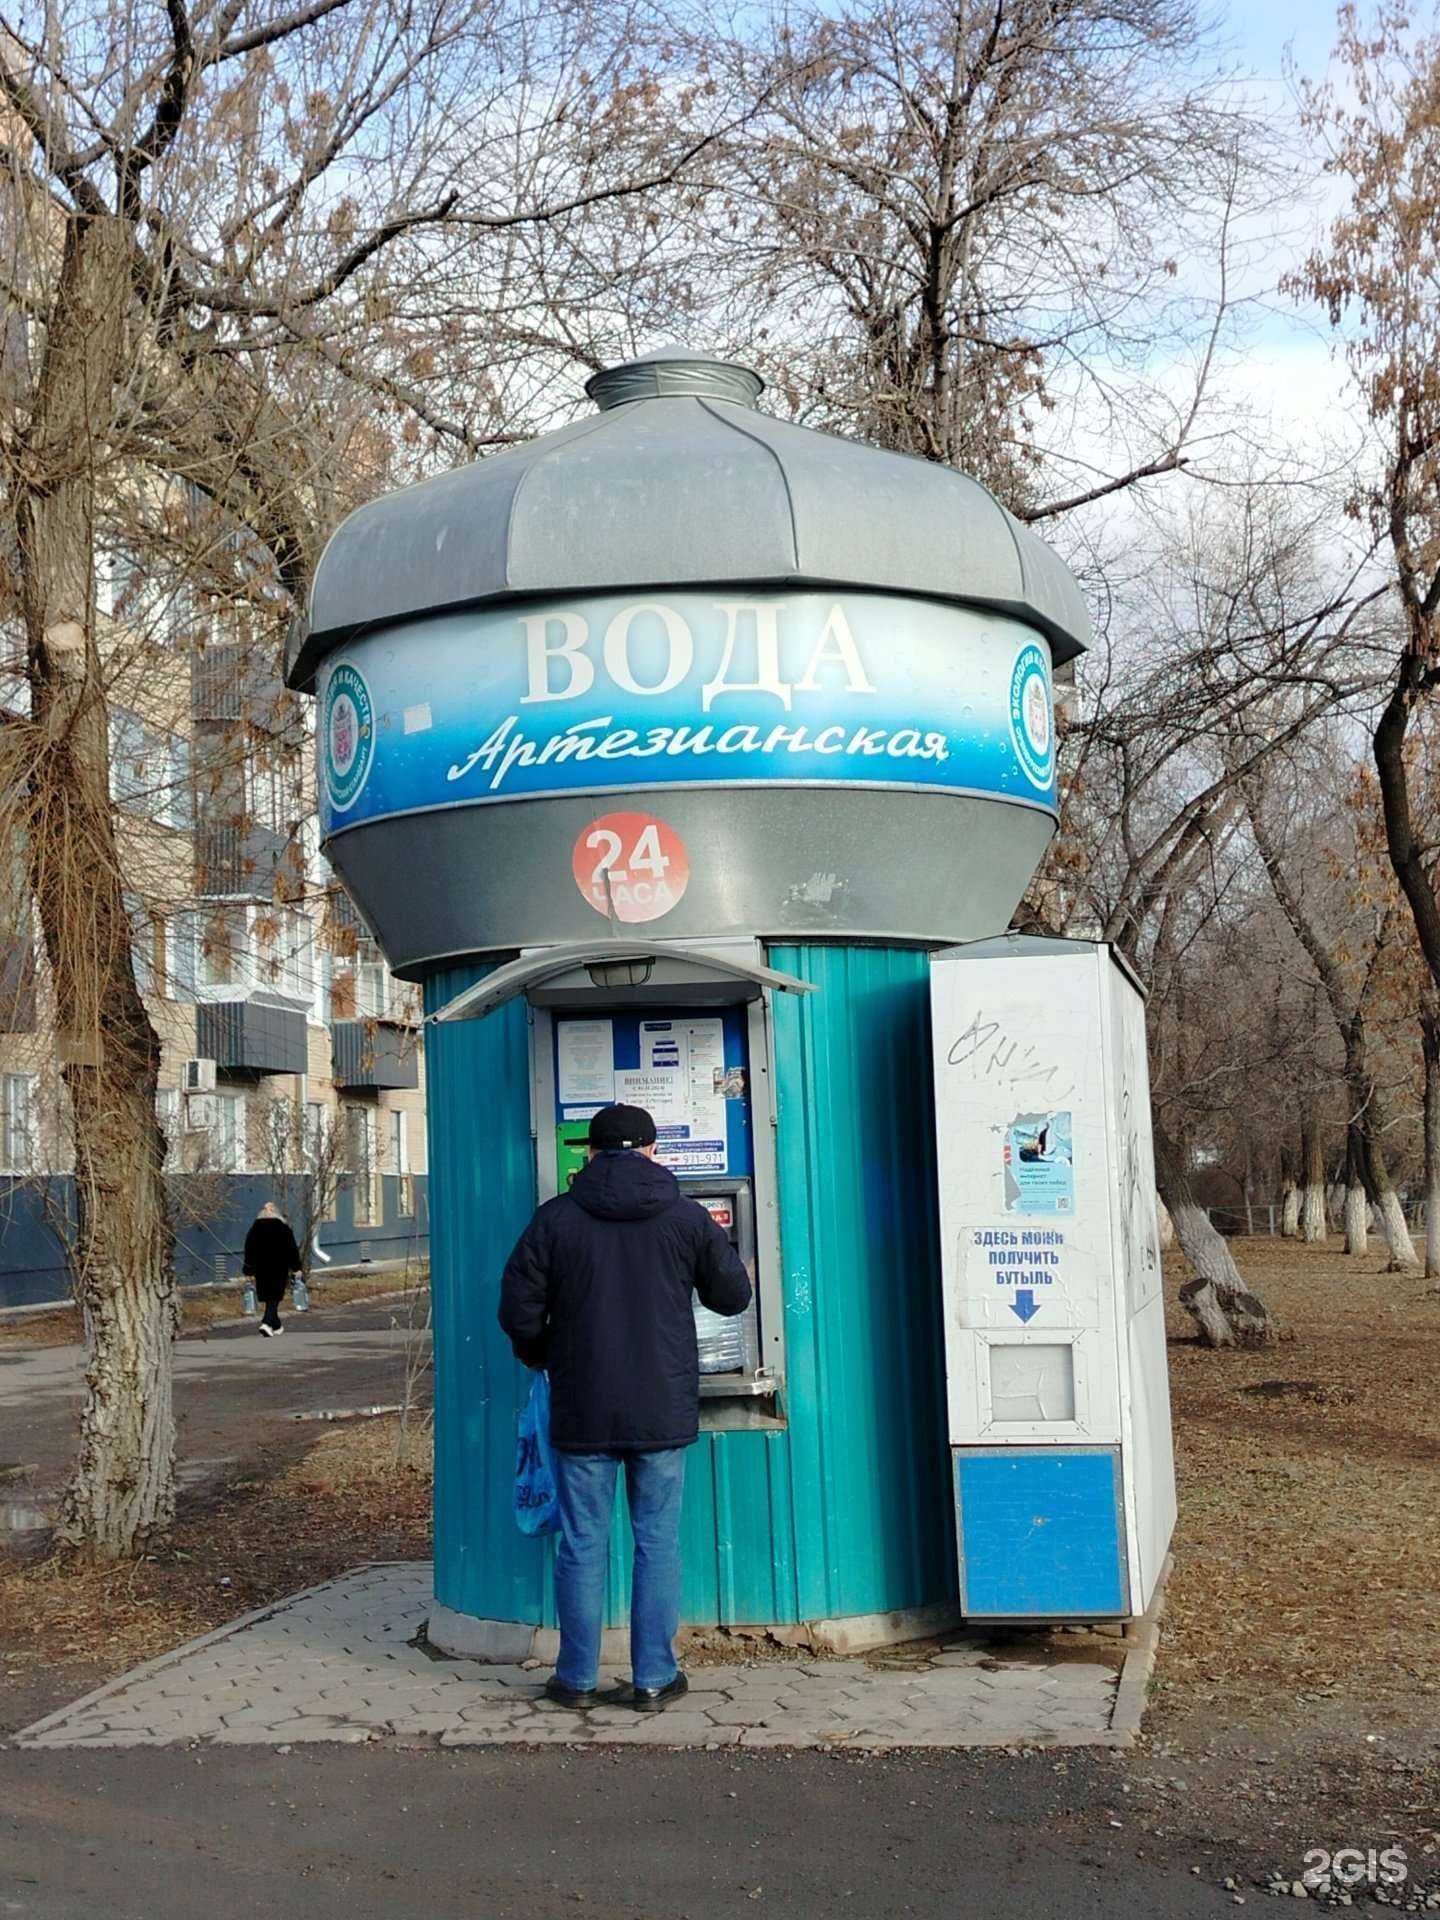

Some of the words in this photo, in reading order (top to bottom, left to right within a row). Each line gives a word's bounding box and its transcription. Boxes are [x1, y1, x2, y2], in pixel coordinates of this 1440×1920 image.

[517, 602, 877, 711] ВОДА
[447, 715, 950, 790] Артезианская
[586, 825, 670, 883] 24
[974, 1231, 1018, 1247] ЗДЕСЬ
[1021, 1230, 1064, 1246] МОЖН
[988, 1251, 1060, 1265] ПОЛУЧИТЬ
[996, 1271, 1053, 1285] БУТЫЛЬ
